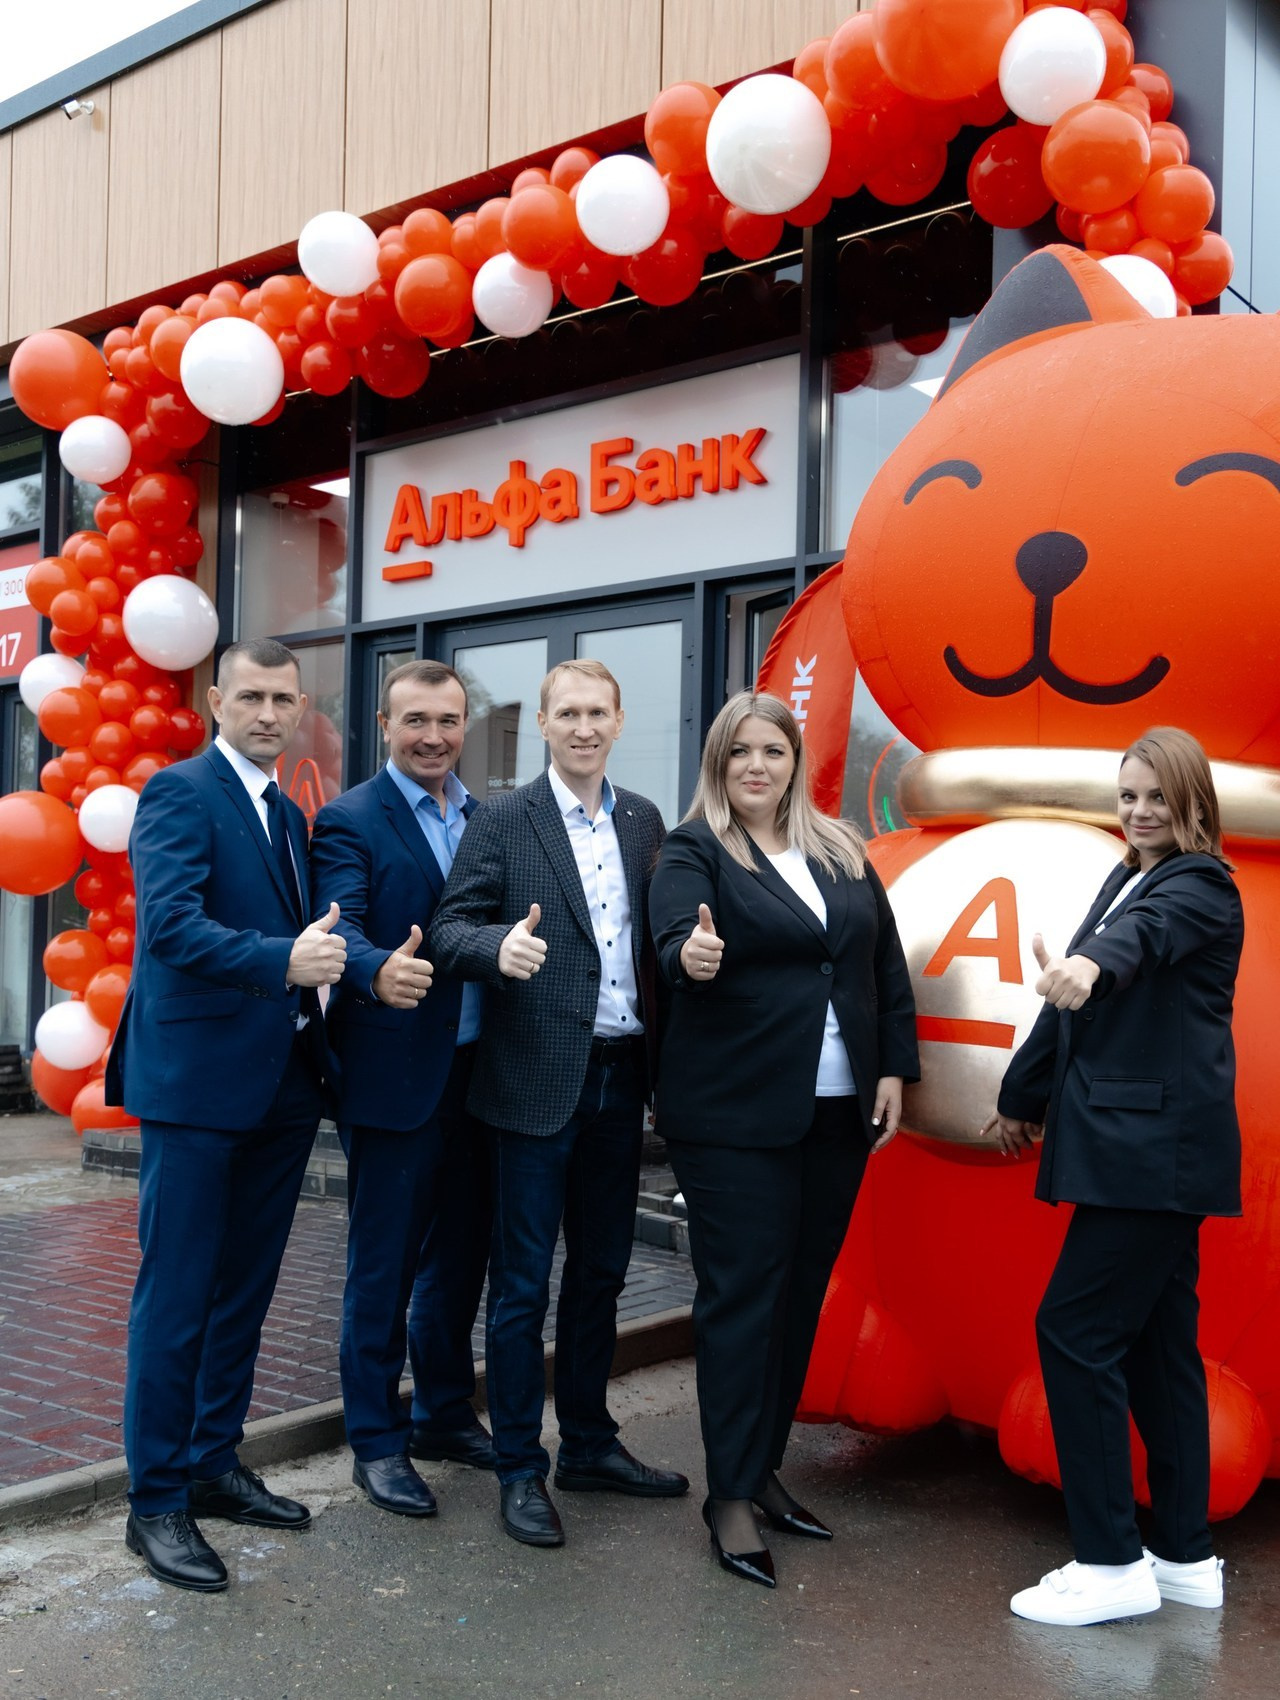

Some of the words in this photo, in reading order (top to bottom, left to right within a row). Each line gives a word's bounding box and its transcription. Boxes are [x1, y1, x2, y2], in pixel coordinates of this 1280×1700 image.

[384, 460, 580, 552] Альфа
[590, 427, 768, 515] Банк
[4, 578, 23, 596] 300
